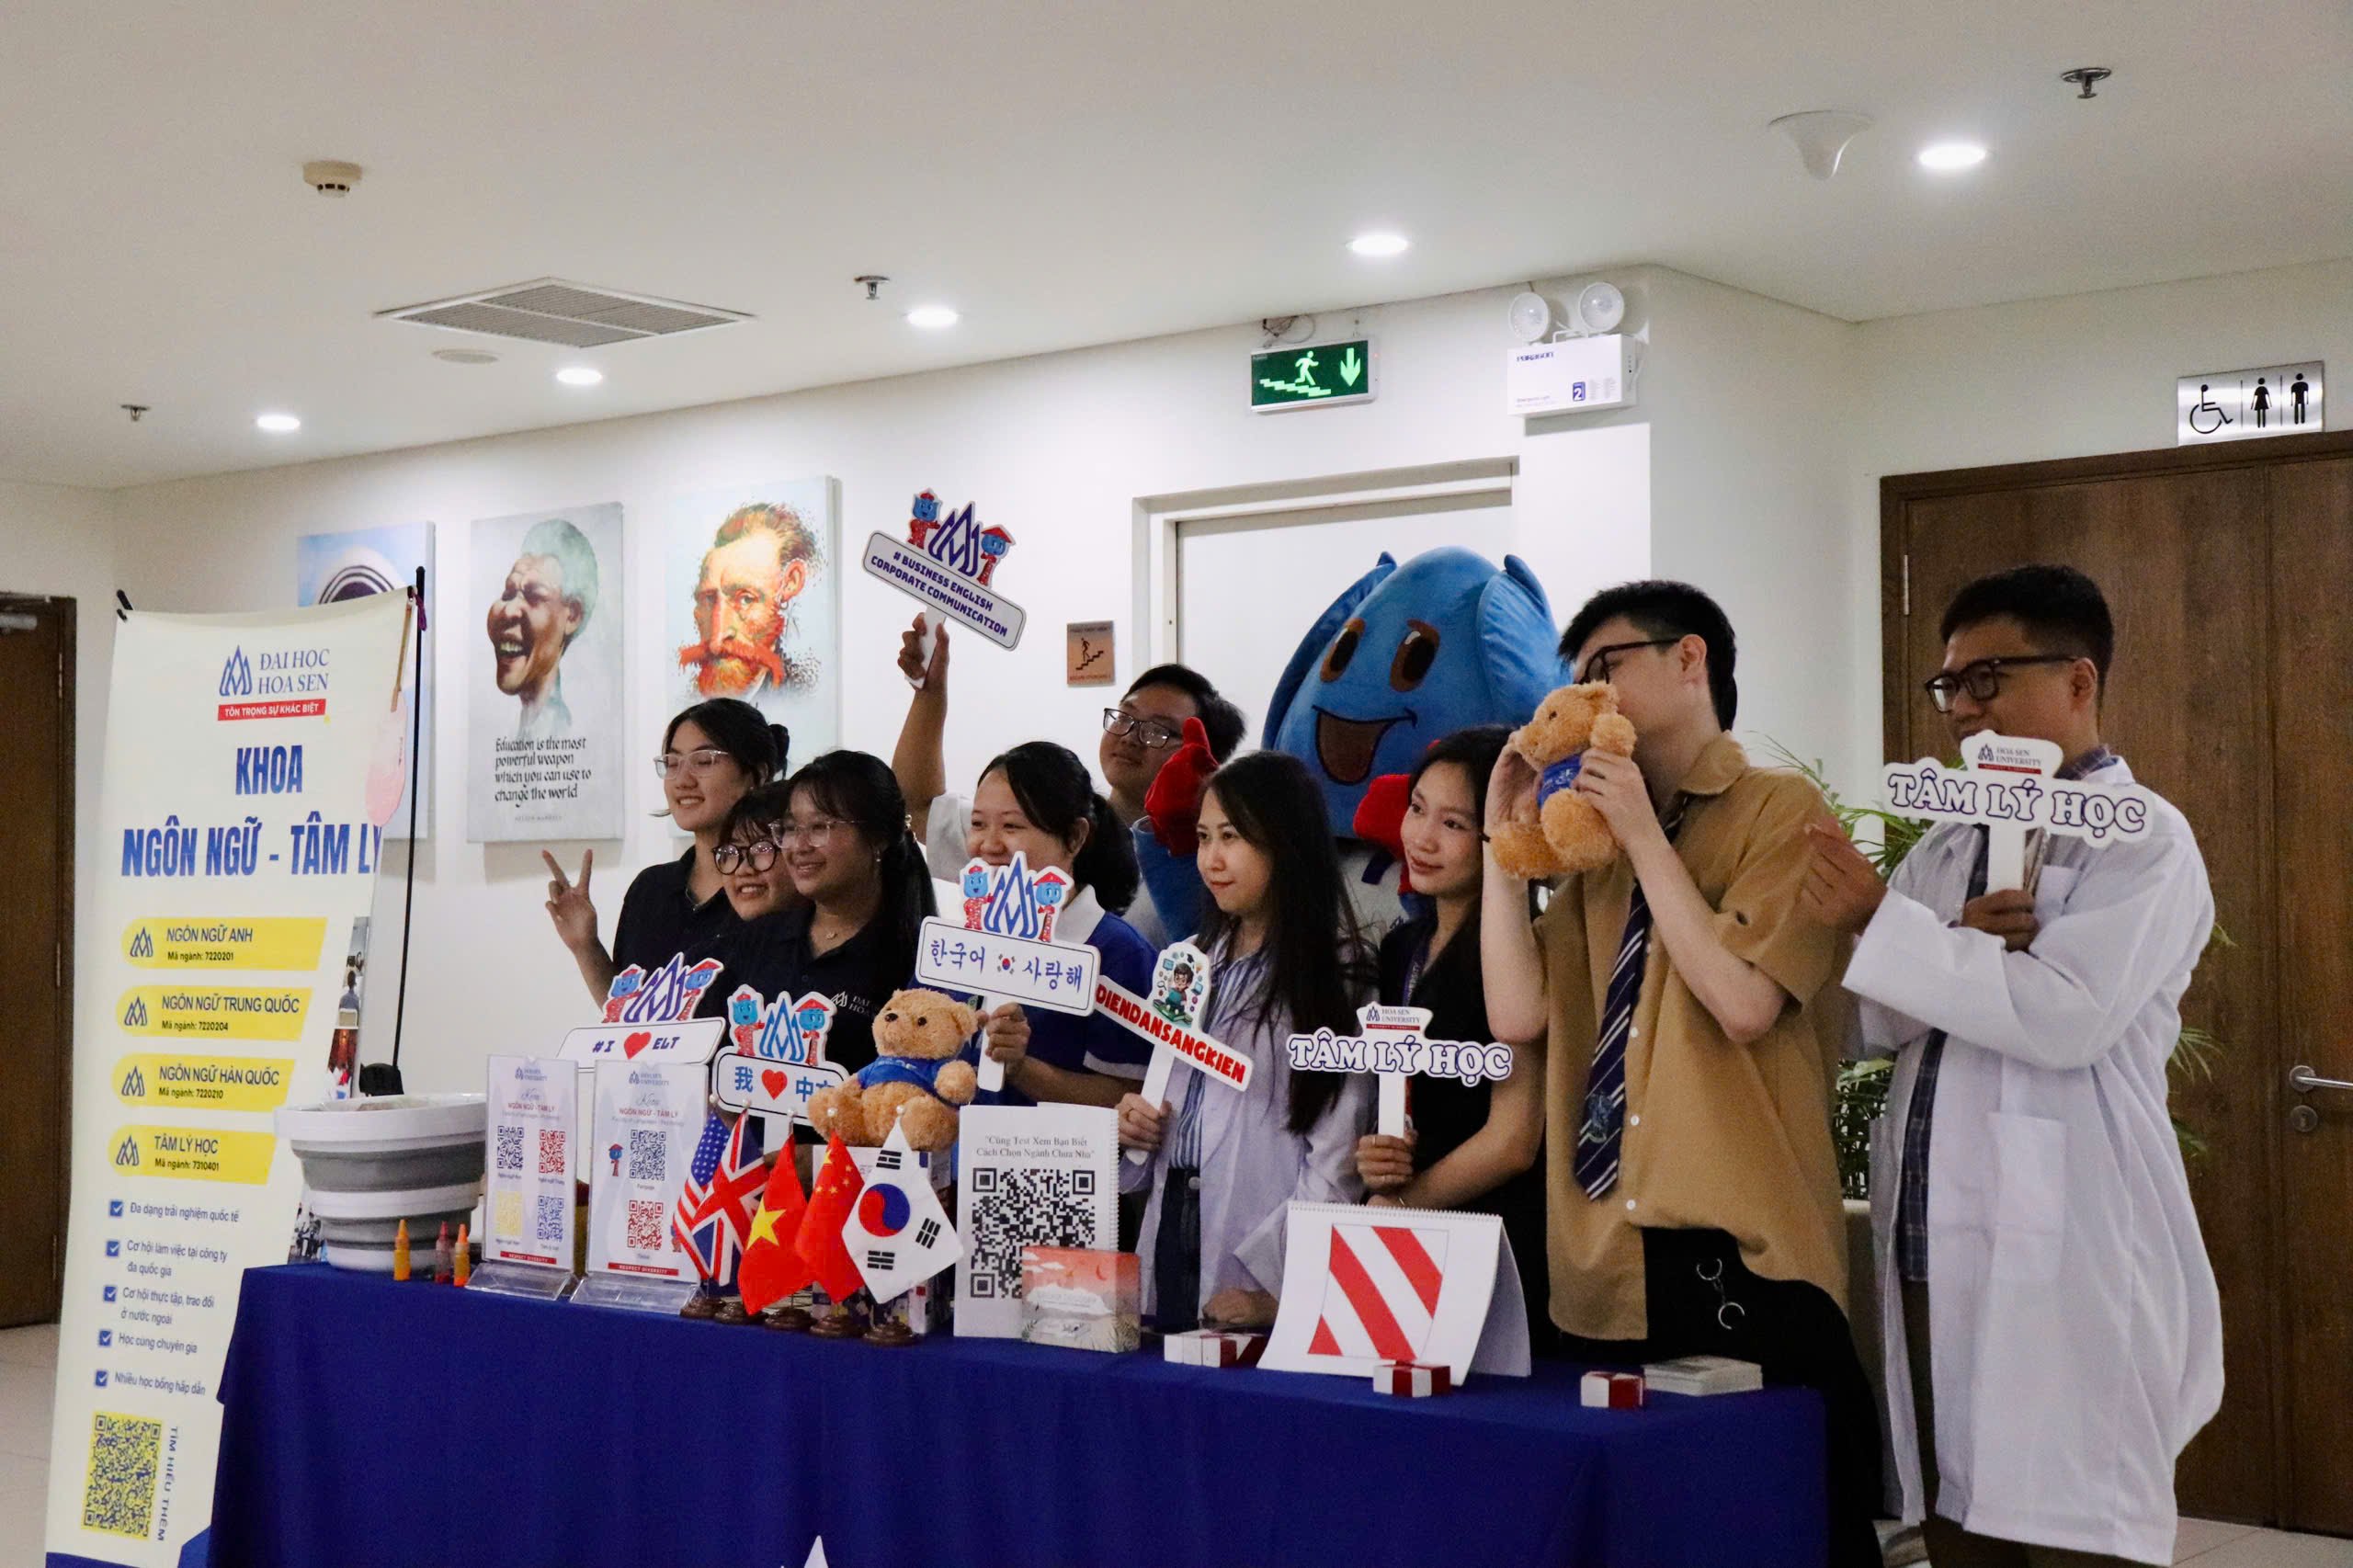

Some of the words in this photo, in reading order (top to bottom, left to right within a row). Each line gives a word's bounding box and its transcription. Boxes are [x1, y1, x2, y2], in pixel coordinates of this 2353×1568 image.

[902, 555, 950, 588] BUSINESS
[950, 582, 993, 611] ENGLISH
[871, 555, 926, 591] CORPORATE
[927, 586, 1007, 636] COMMUNICATION
[258, 675, 293, 694] HOA
[298, 673, 329, 691] SEN
[242, 706, 267, 717] TRỌNG
[279, 703, 301, 713] KHÁC
[495, 736, 534, 752] Education
[537, 738, 544, 751] is
[546, 736, 561, 750] the
[561, 737, 586, 750] most
[235, 744, 302, 795] KHOA
[495, 752, 536, 771] powerful
[537, 753, 574, 767] weapon
[1995, 756, 2041, 767] UNIVERSITY
[494, 771, 522, 783] which
[524, 772, 542, 788] you
[543, 771, 561, 781] can
[563, 770, 580, 781] use
[582, 768, 591, 779] to
[494, 788, 529, 808] change
[531, 787, 547, 801] the
[548, 783, 578, 799] world
[1888, 767, 1977, 814] TÂM
[1986, 778, 2043, 821] LÝ
[2051, 790, 2146, 838] HỌC
[121, 815, 198, 876] NGÔN
[205, 816, 263, 876] NGỮ
[290, 811, 350, 875] TÂM
[166, 925, 199, 941] NGÔN
[201, 924, 228, 941] NGỮ
[229, 927, 253, 942] ANH
[205, 951, 233, 960] 7220201
[930, 938, 985, 973] 한국어
[1022, 956, 1083, 993] 사랑해
[162, 993, 193, 1010] NGÔN
[196, 994, 222, 1011] NGỮ
[223, 997, 262, 1012] TRUNG
[265, 994, 300, 1013] QUỐC
[199, 1022, 228, 1031] 7220204
[1095, 983, 1246, 1085] DIENDANSANGKIEN
[652, 1037, 680, 1050] ELT
[1290, 1030, 1367, 1071] TÂM
[1374, 1035, 1422, 1074] LÝ
[1429, 1044, 1511, 1085] HỌC
[159, 1063, 190, 1081] NGÔN
[193, 1064, 218, 1082] NGỮ
[245, 1066, 279, 1085] QUỐC
[734, 1066, 754, 1093] 我
[196, 1088, 223, 1098] 7220210
[154, 1133, 177, 1151] TÂM
[195, 1138, 219, 1157] HỌC
[1014, 1136, 1030, 1145] Test
[1032, 1136, 1051, 1145] Xem
[192, 1160, 219, 1171] 7310401
